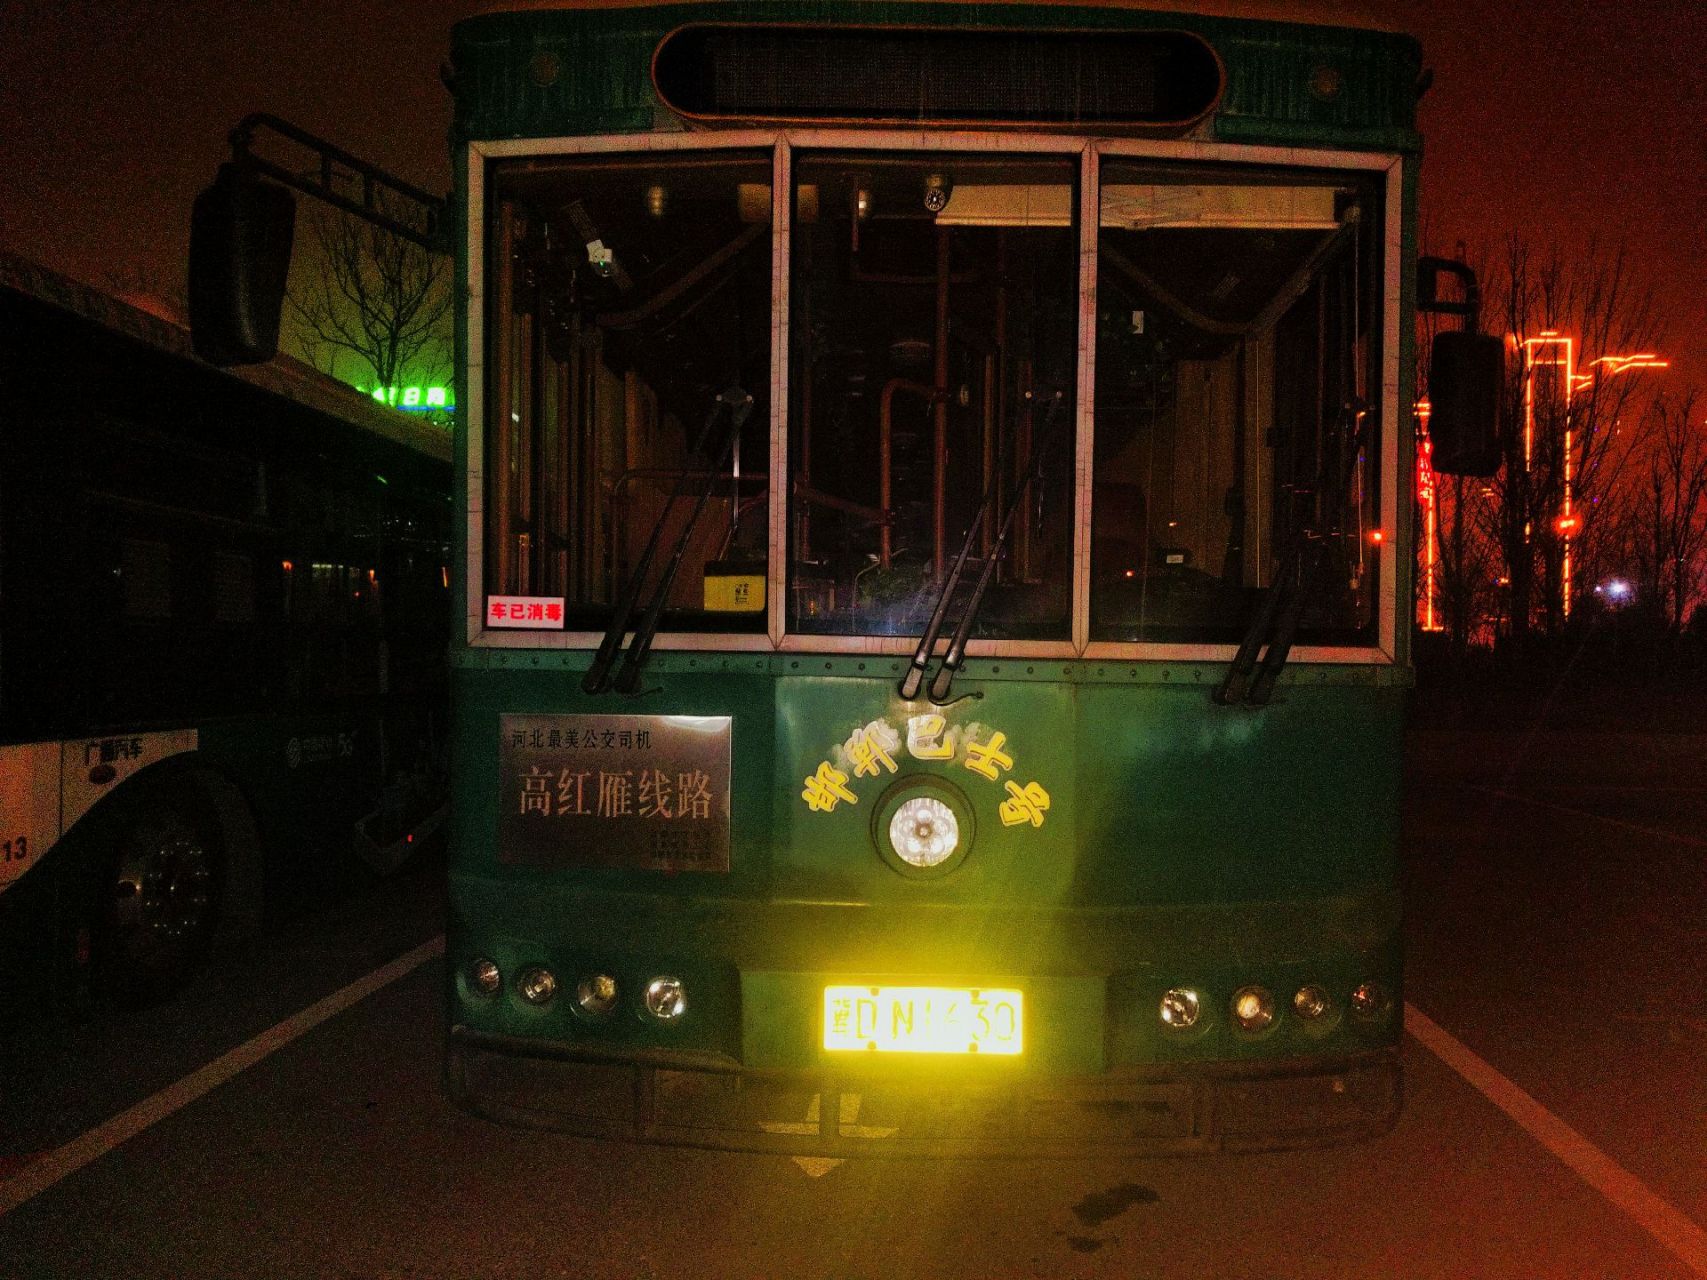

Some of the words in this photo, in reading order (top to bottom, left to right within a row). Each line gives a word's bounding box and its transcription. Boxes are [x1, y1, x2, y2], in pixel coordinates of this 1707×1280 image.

[491, 602, 562, 621] 车已消毒
[511, 728, 652, 750] 河北最美公交司机
[517, 766, 714, 821] 高红雁线路
[3, 836, 27, 862] 13
